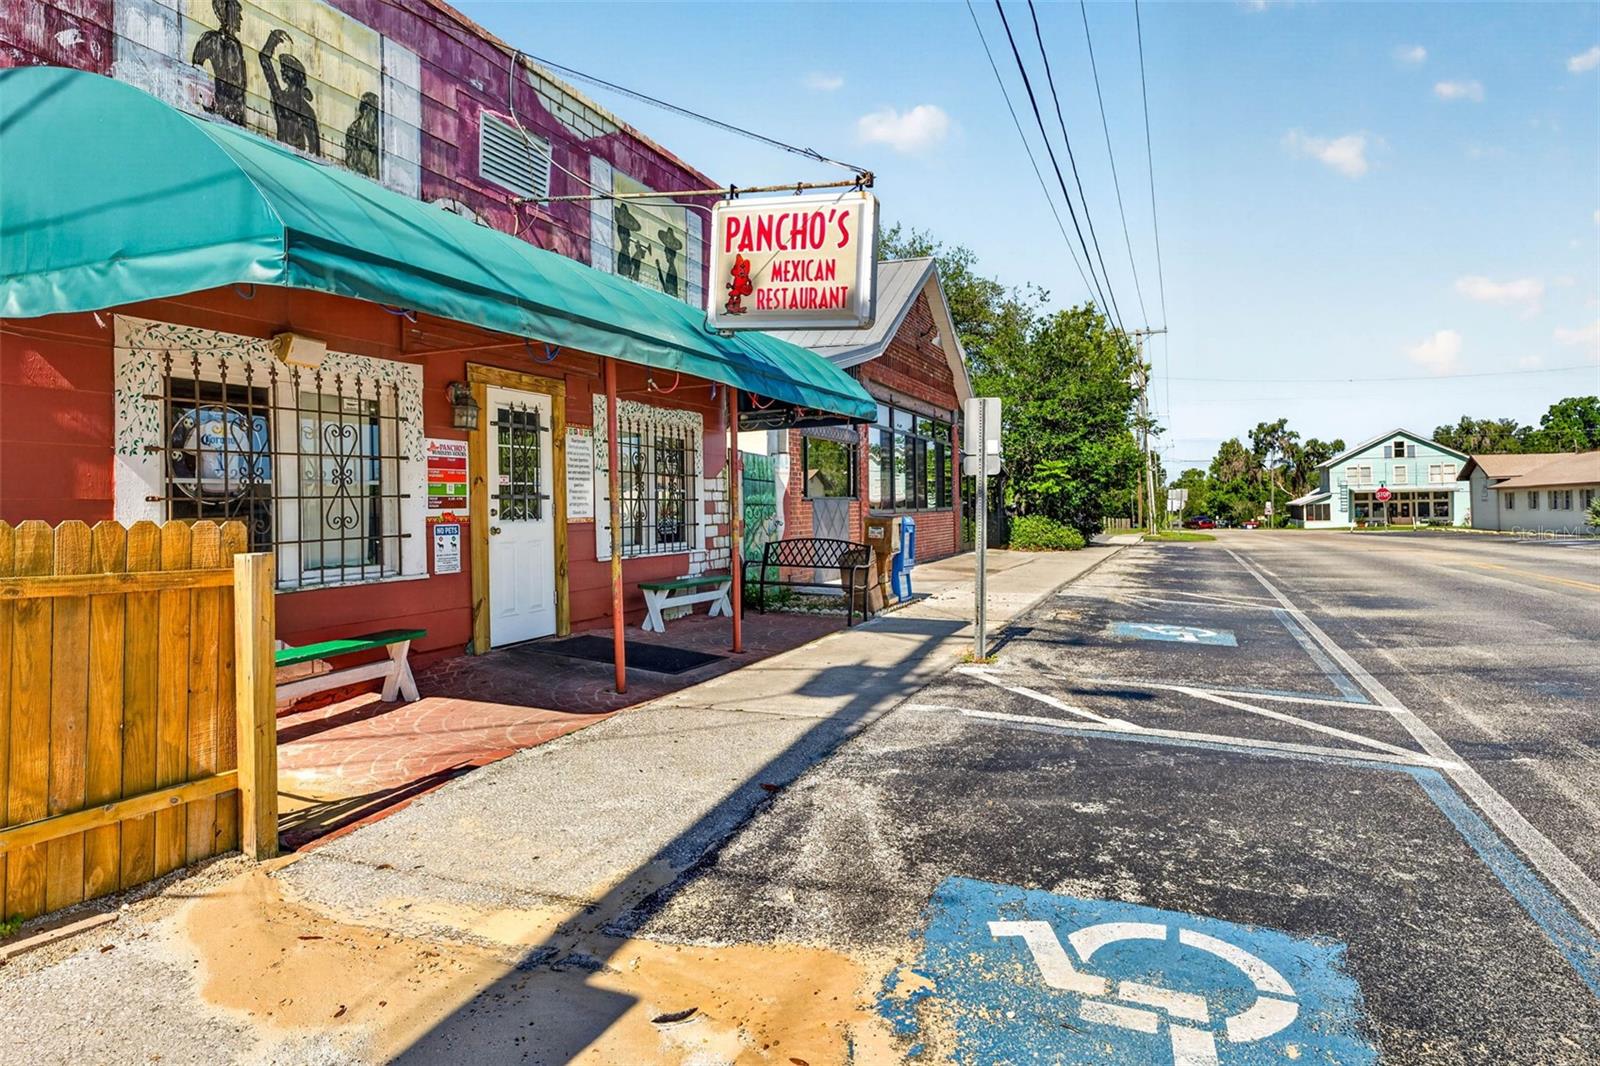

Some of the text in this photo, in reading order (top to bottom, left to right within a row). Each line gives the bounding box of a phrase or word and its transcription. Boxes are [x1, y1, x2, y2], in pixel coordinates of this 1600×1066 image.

[725, 209, 850, 253] PANCHO'S
[771, 258, 836, 283] MEXICAN
[756, 286, 848, 310] RESTAURANT
[436, 526, 458, 535] NO PETS
